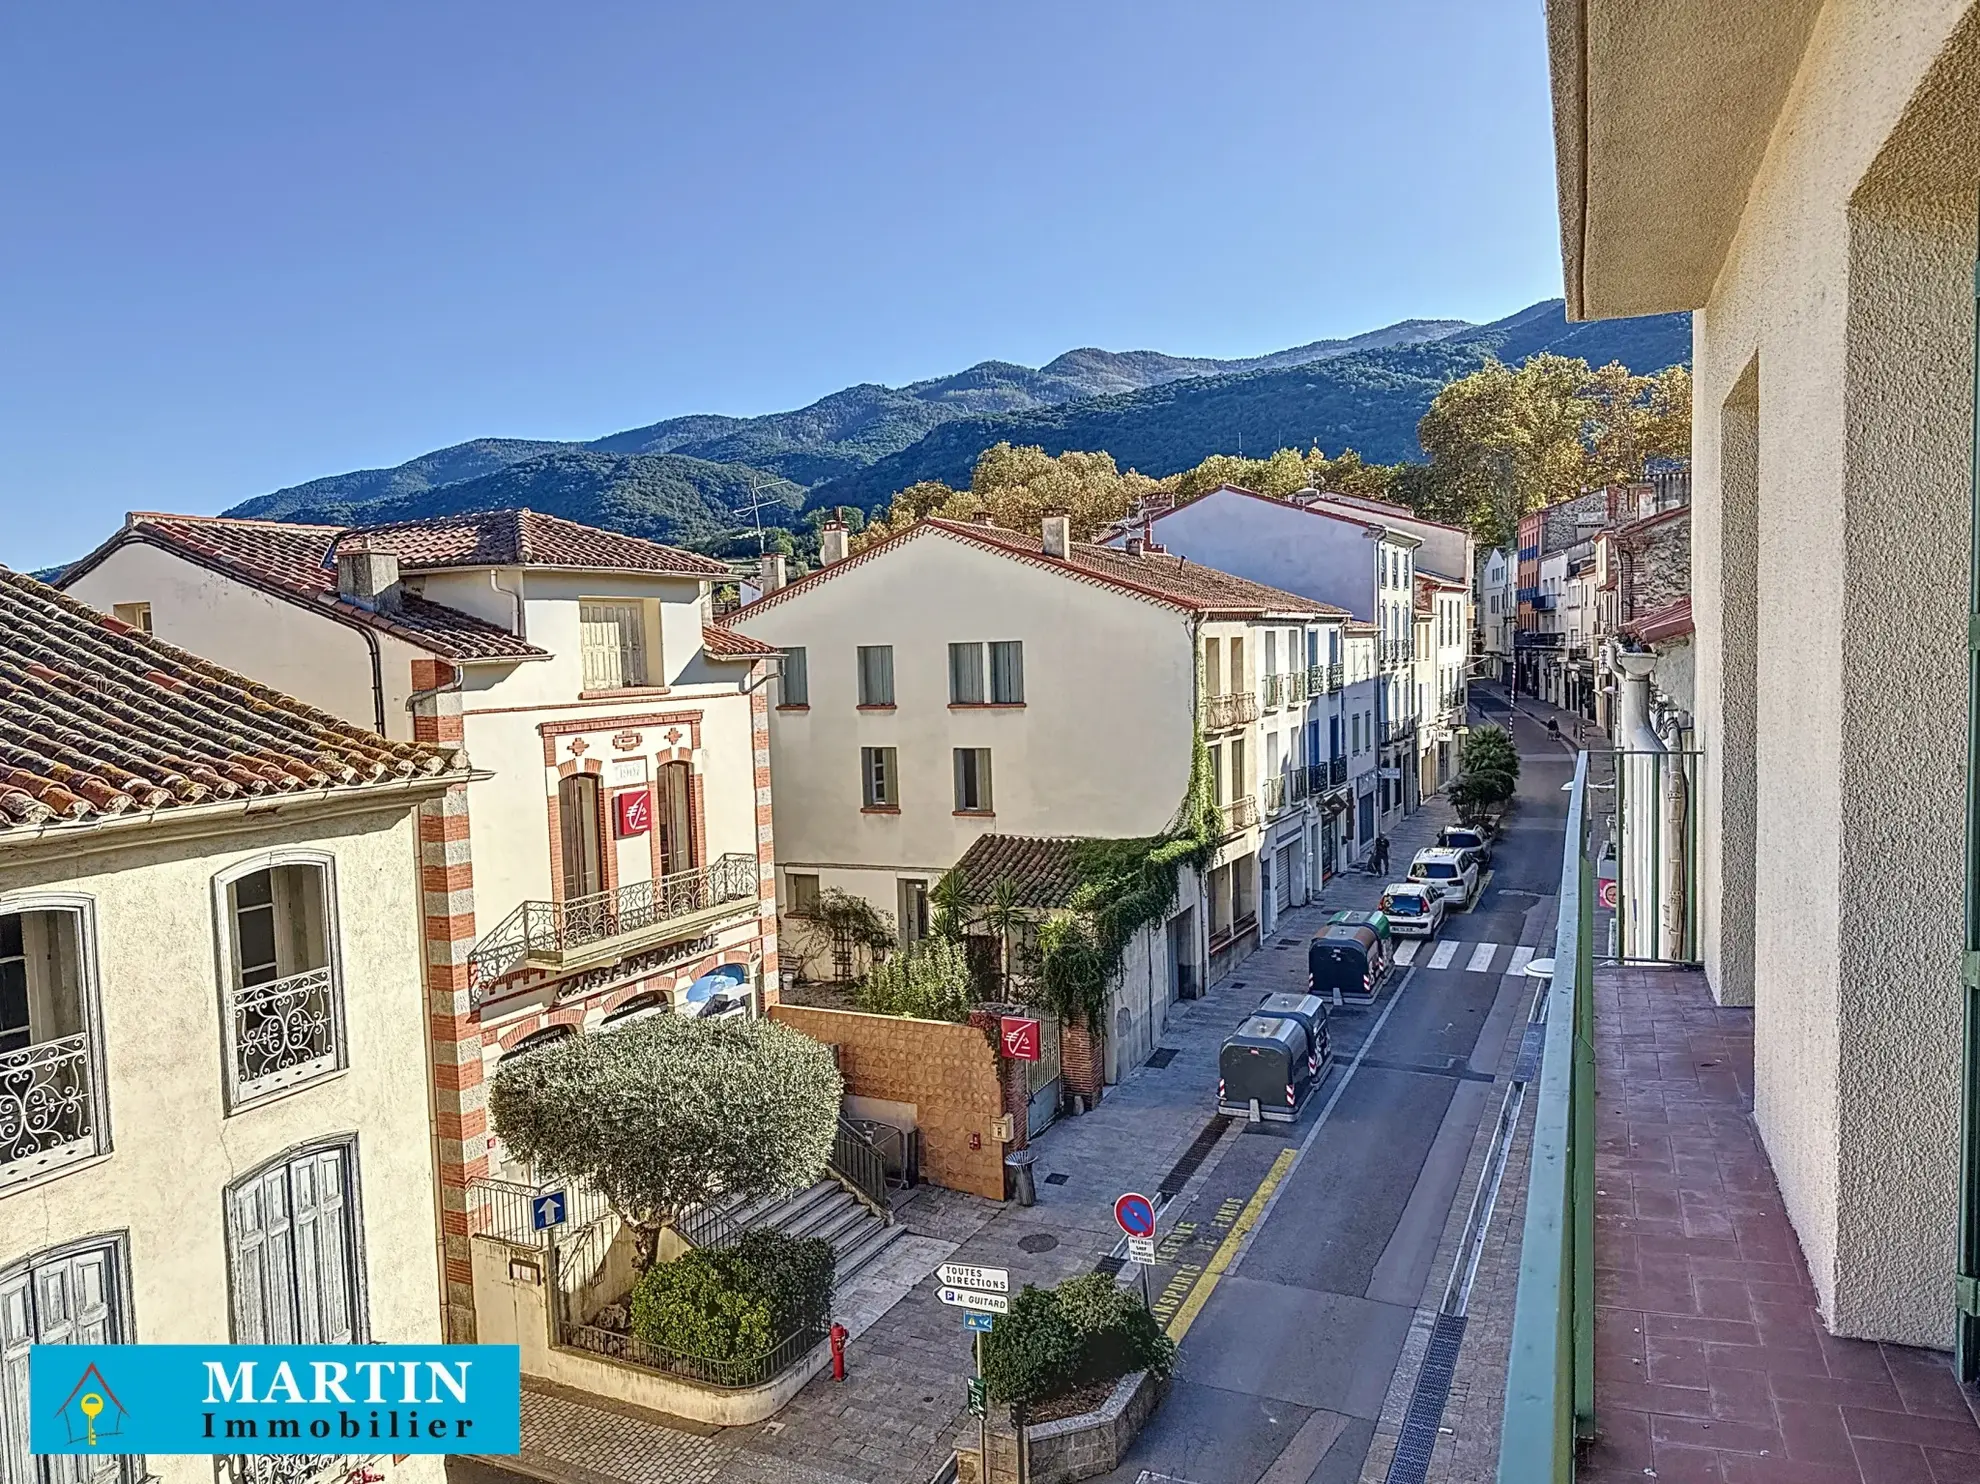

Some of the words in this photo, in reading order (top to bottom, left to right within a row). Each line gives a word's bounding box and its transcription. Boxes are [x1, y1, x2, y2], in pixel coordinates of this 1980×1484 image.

[557, 962, 626, 999] CAISSE
[946, 1266, 983, 1278] TOUTES
[946, 1275, 1006, 1290] DIRECTIONS
[968, 1295, 1006, 1309] GUITARD
